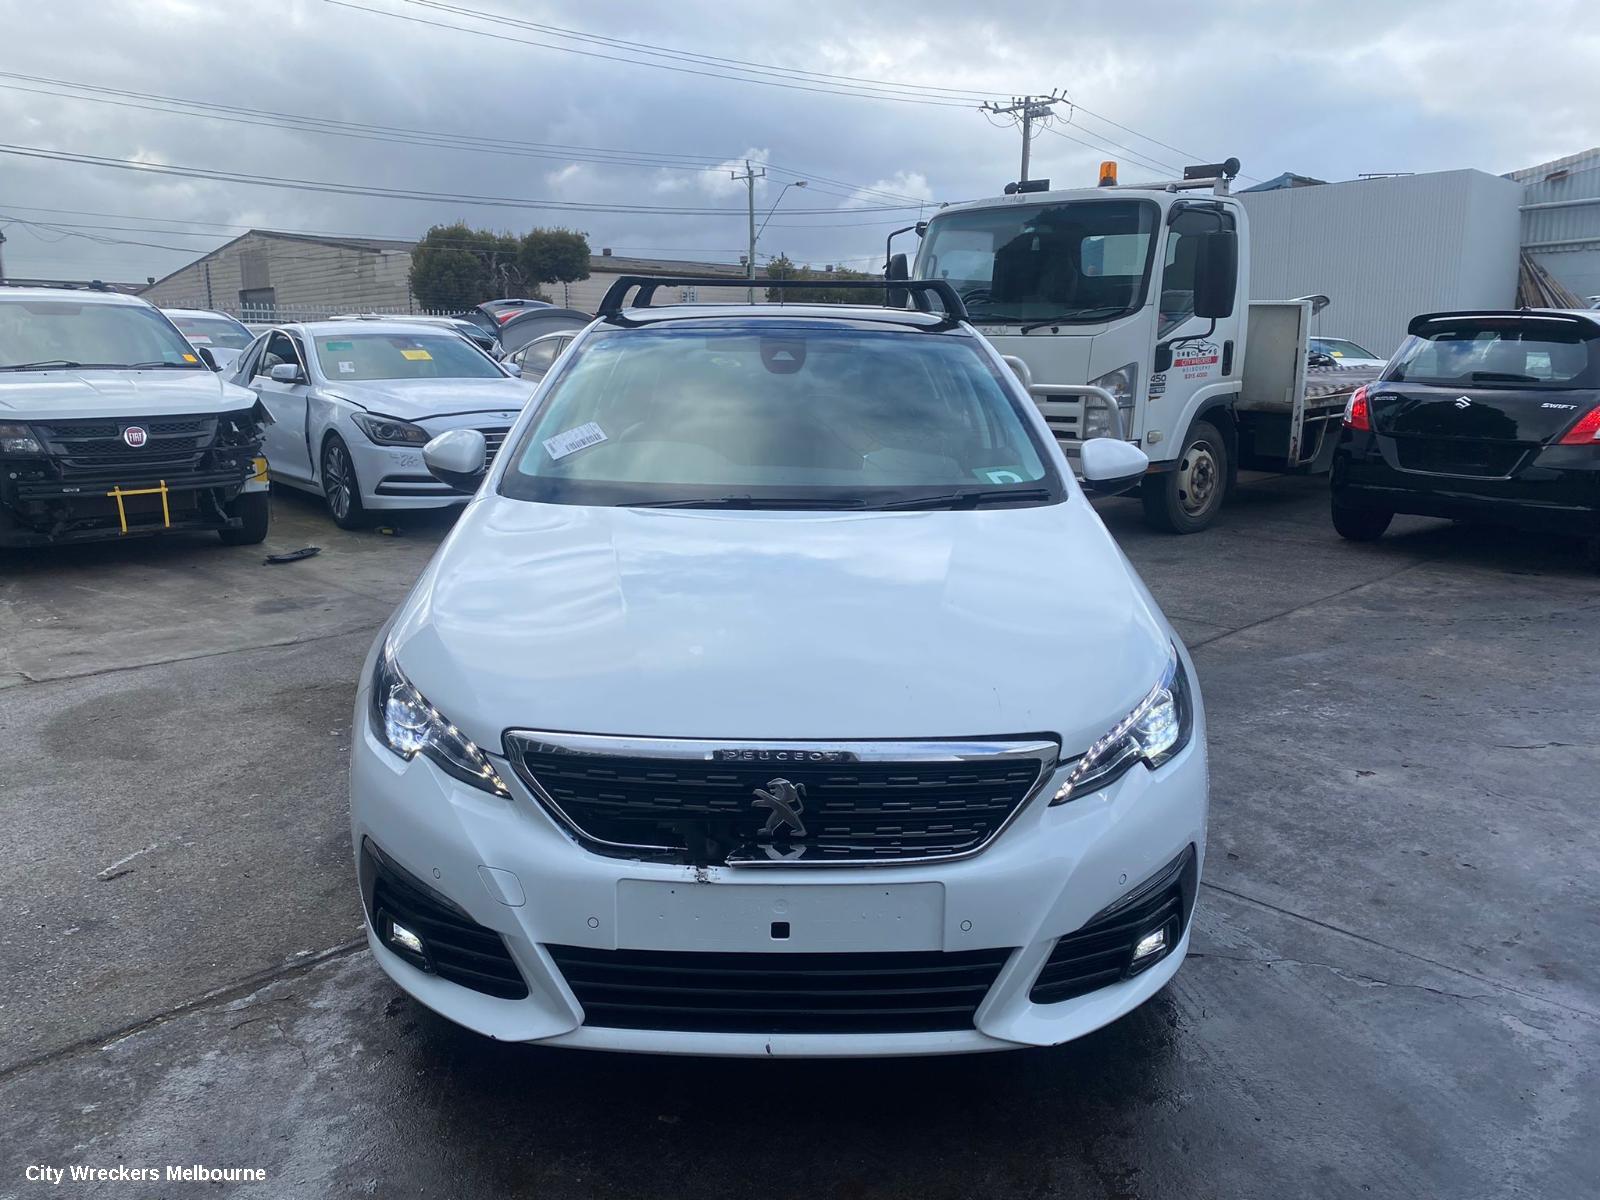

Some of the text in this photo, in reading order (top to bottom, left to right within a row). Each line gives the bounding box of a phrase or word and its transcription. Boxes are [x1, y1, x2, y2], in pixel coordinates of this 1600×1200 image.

[1150, 374, 1167, 382] 450
[1540, 402, 1578, 410] SWIFT
[128, 432, 143, 442] FIAT
[726, 750, 839, 761] PEUGEOT
